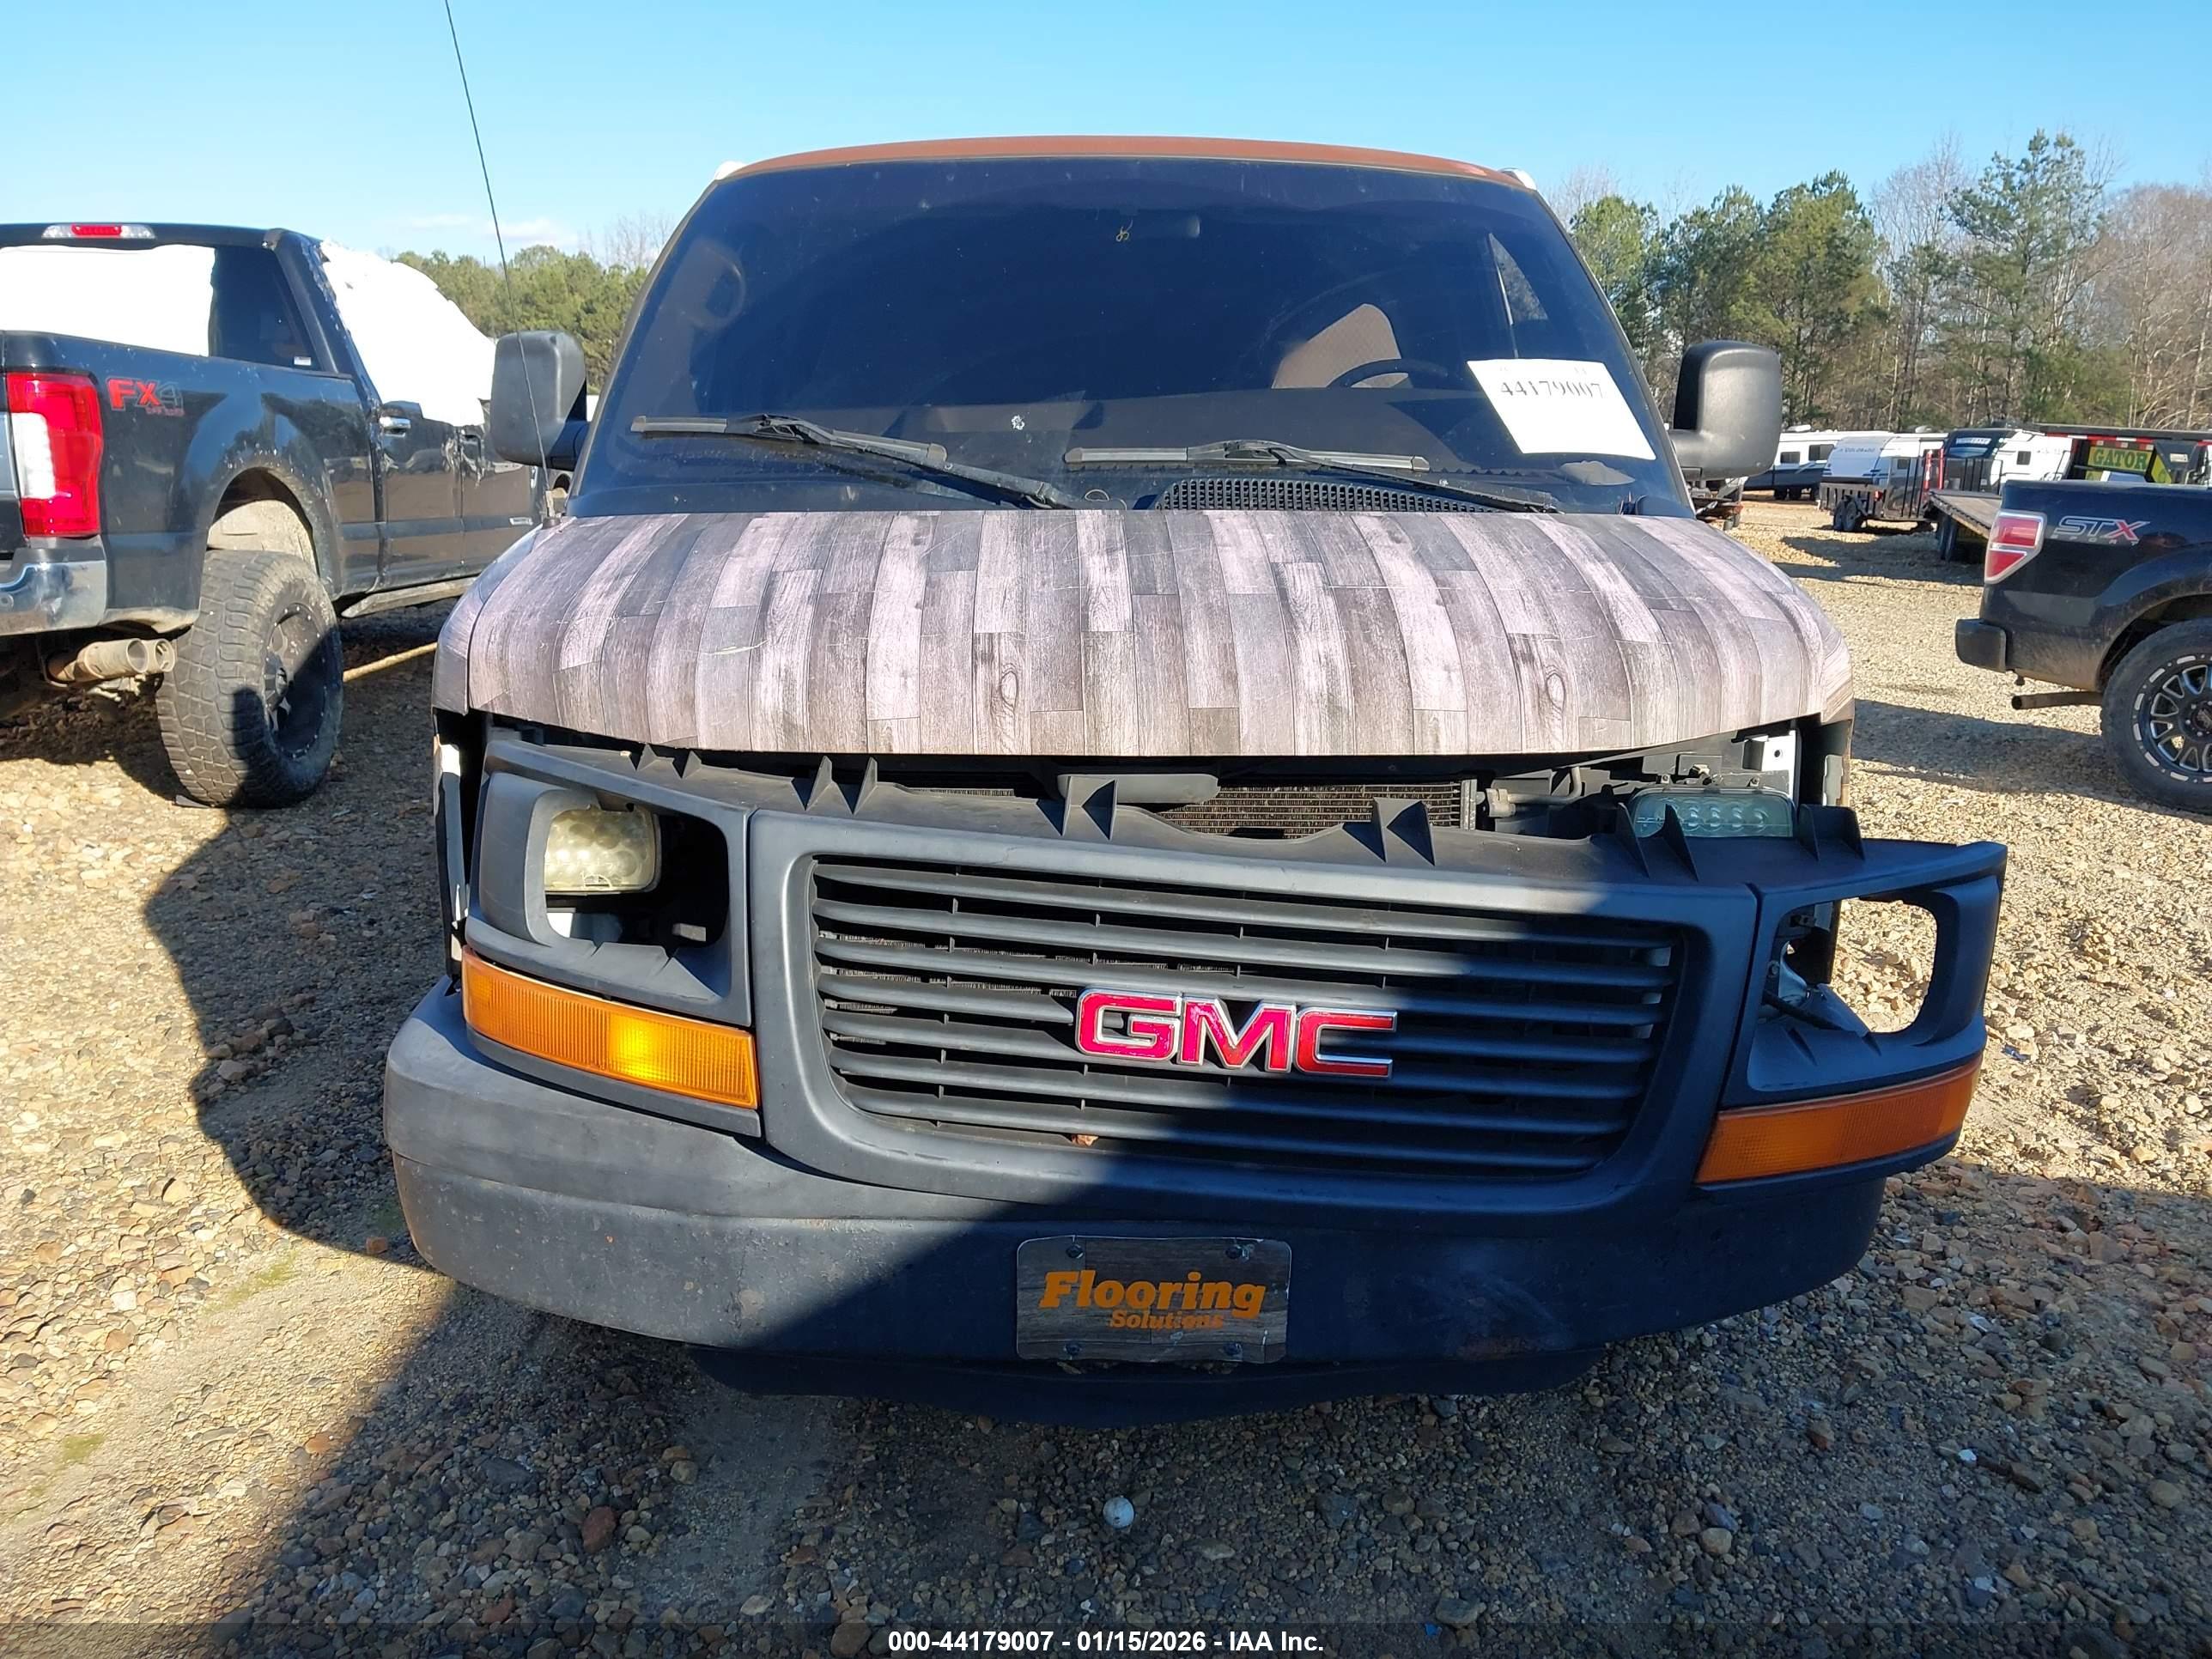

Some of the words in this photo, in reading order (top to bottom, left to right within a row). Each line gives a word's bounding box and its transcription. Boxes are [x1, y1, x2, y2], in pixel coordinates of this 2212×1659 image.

[106, 375, 183, 414] FX4
[2093, 446, 2148, 470] GATOR
[2053, 515, 2150, 542] STX
[1075, 987, 1398, 1078] GMC
[1039, 1269, 1267, 1320] Flooring
[1109, 1309, 1224, 1330] Solutions
